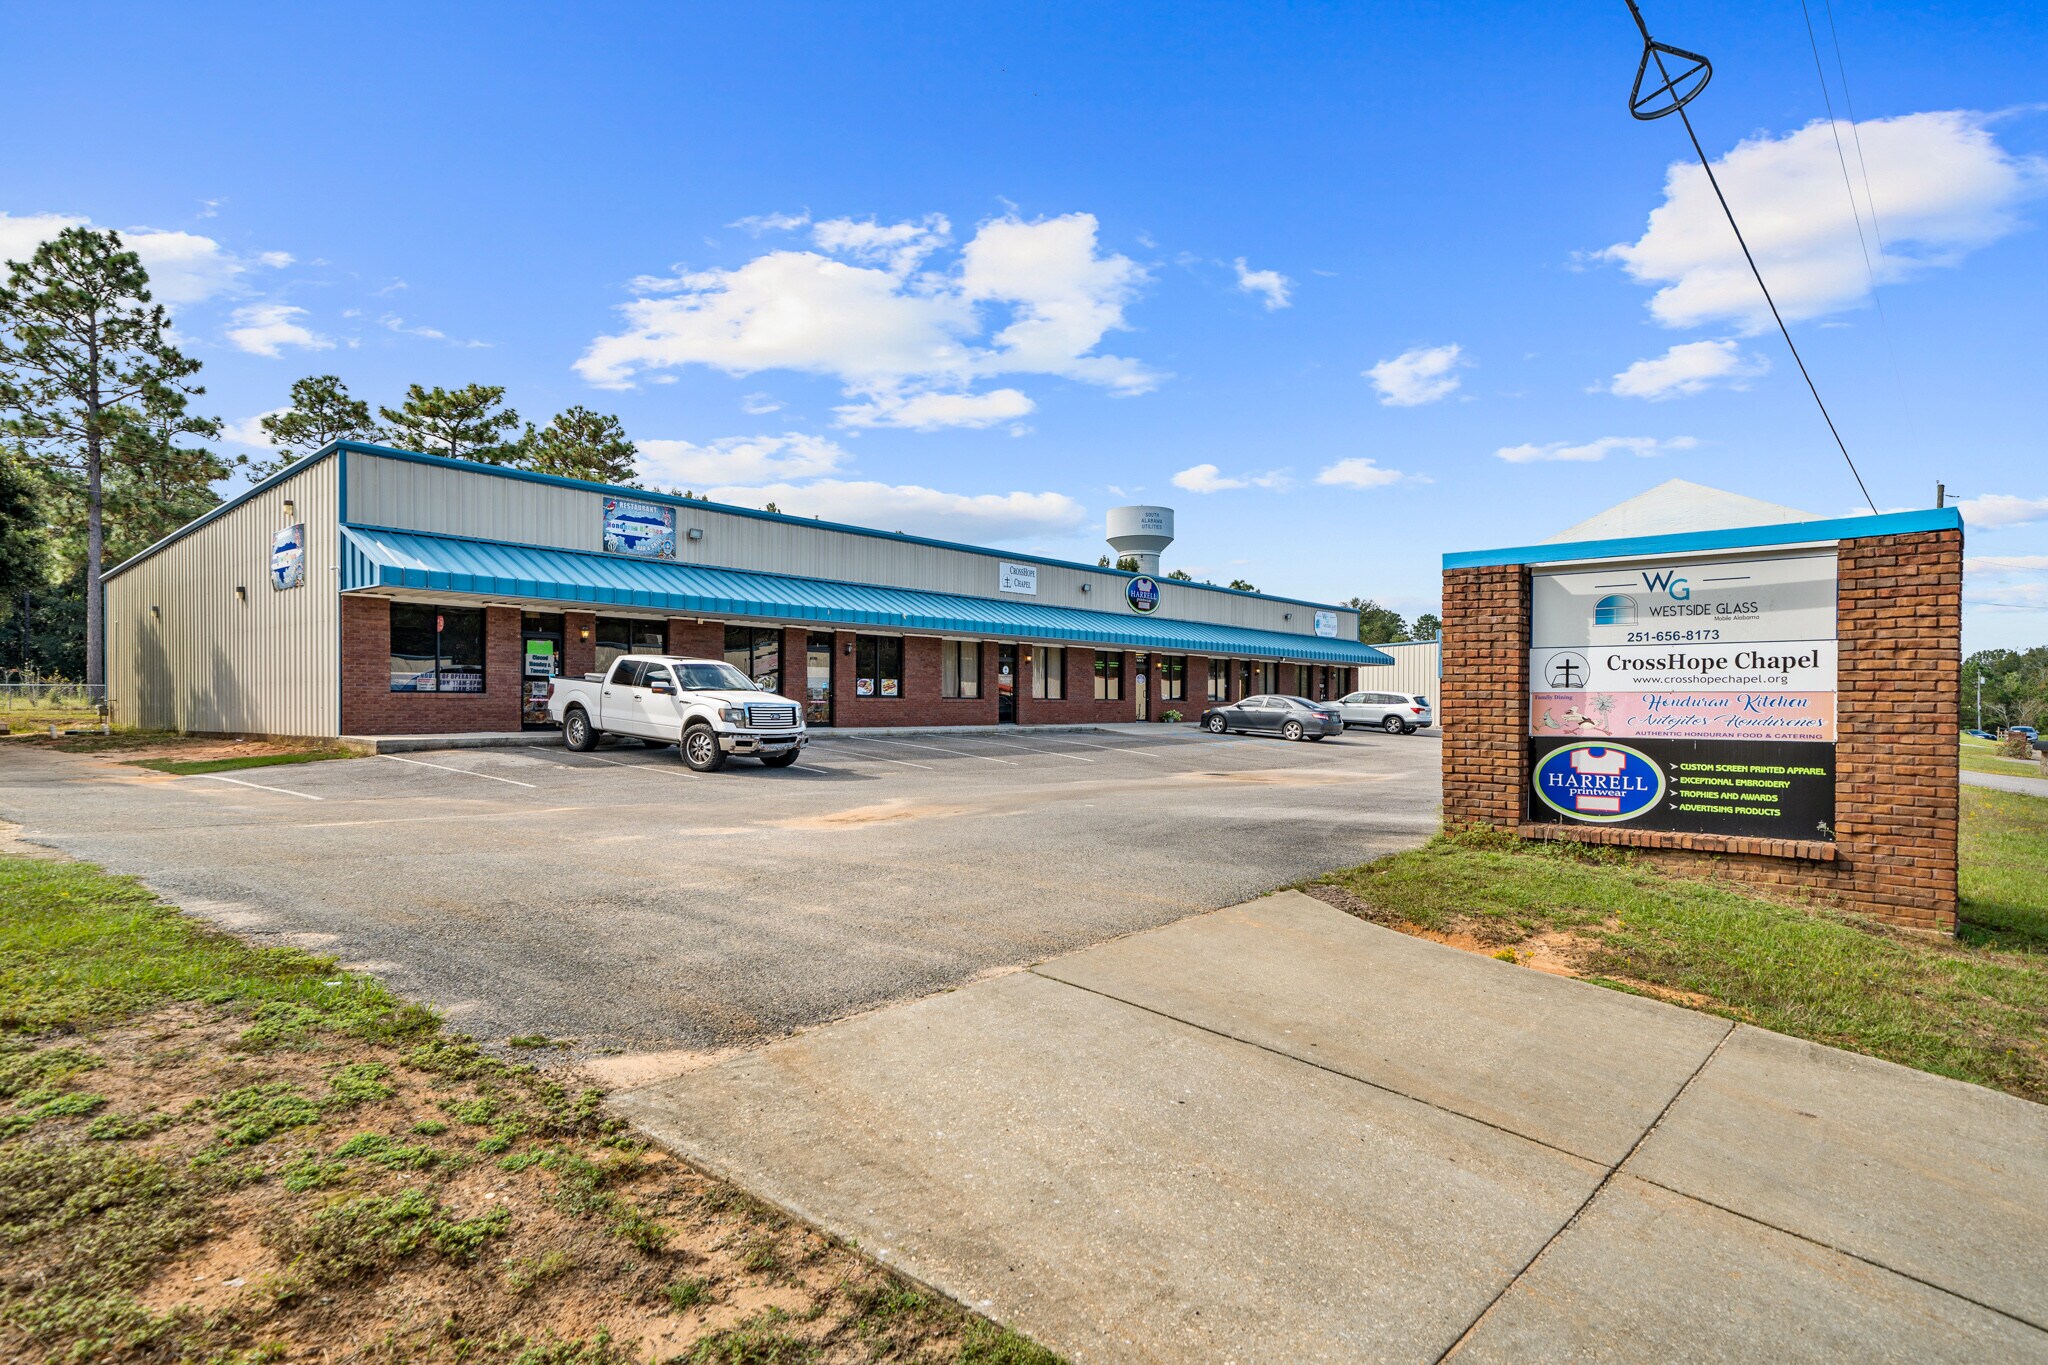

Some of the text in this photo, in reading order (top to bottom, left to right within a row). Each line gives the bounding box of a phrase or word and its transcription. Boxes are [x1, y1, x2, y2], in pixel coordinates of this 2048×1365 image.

[619, 501, 657, 513] RESTAURANT
[1130, 590, 1157, 600] HARRELL
[1649, 602, 1758, 617] WESTSIDE GLASS
[1627, 629, 1720, 642] 251-656-8173
[1607, 650, 1819, 674] CrossHope Chapel
[1633, 674, 1788, 685] www.crosshopechapel.org
[1535, 694, 1573, 702] Family Dining
[1643, 693, 1808, 713] Honduran Kitchen
[1680, 763, 1826, 776] CUSTOM SCREEN PRINTED APPAREL
[1548, 773, 1648, 791] HARRELL
[1680, 776, 1790, 788] EXCEPTIONAL EMBROIDERY
[1569, 787, 1627, 796] printwear
[1680, 790, 1778, 802] TROPHIES AND AWARDS
[1679, 803, 1782, 816] ADVERTISING PRODUCTS
